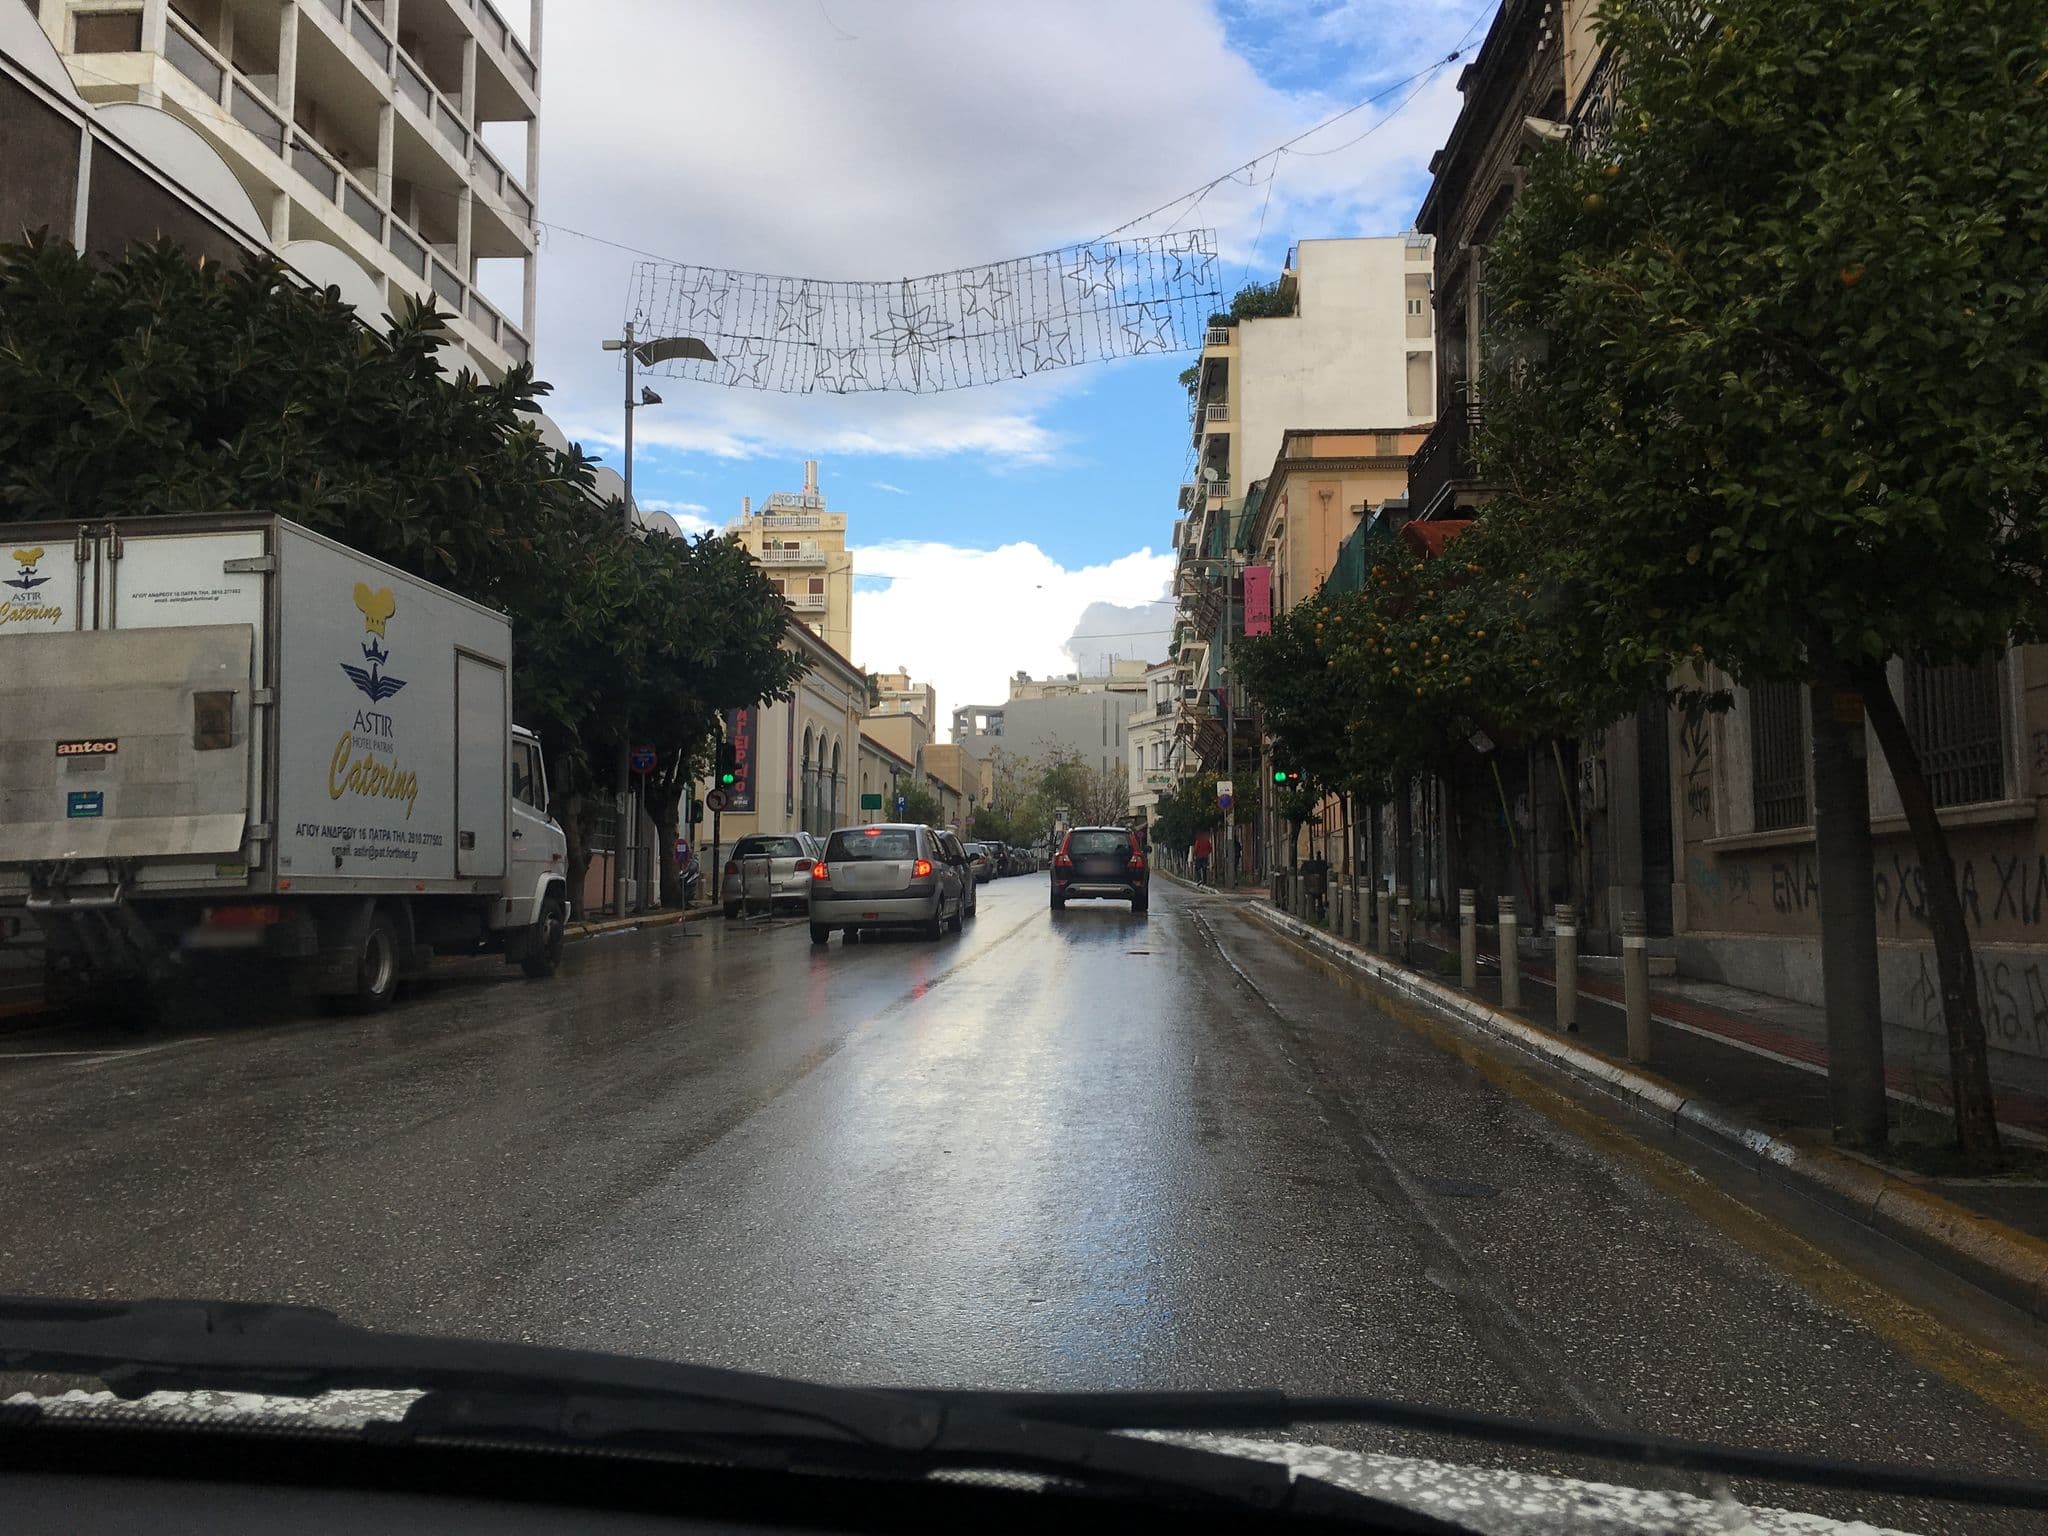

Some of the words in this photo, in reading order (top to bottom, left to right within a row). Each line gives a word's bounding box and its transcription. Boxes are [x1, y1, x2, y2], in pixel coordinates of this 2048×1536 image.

[12, 592, 42, 602] ASTIR
[0, 602, 62, 625] Catering
[353, 708, 393, 738] ASTIR
[57, 741, 117, 754] anteo
[352, 735, 372, 751] HOTEL
[328, 729, 418, 820] Catering
[295, 823, 319, 838] ΑΓΙΟΥ
[368, 828, 391, 841] ΠΑΤΡΑ
